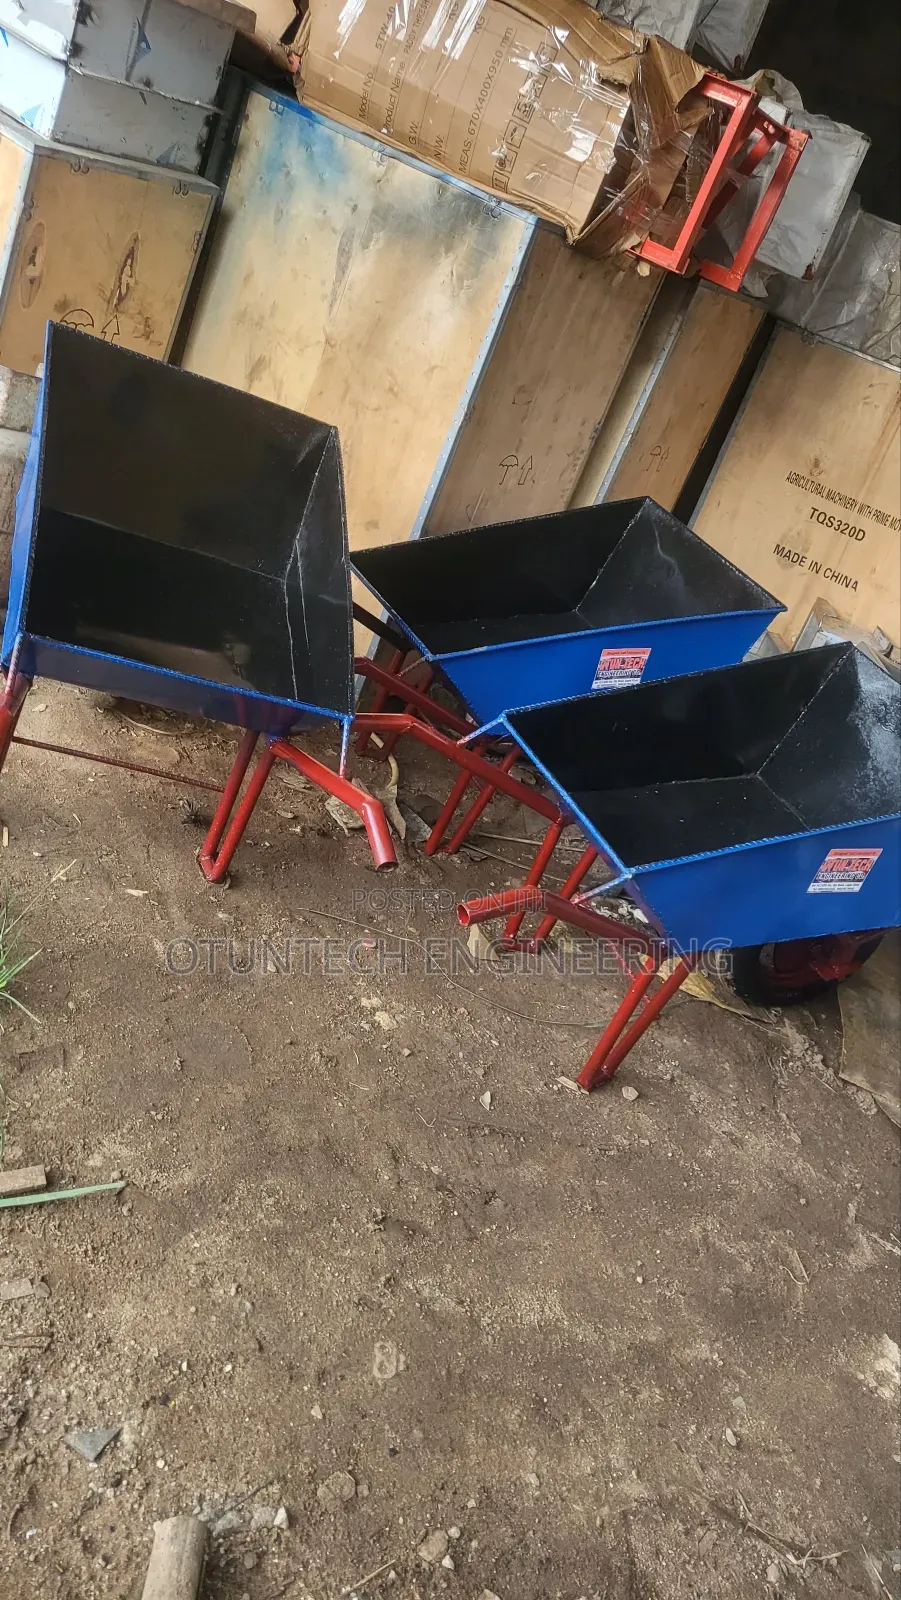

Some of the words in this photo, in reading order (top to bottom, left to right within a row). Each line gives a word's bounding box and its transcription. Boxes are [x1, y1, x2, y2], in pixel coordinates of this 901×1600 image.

[391, 61, 405, 94] Name
[403, 30, 417, 55] PADDY
[467, 50, 503, 137] 670X400X950
[500, 27, 514, 50] mm
[359, 91, 370, 119] Model
[785, 470, 826, 499] AGRICULTURAL
[825, 487, 859, 512] MACHINERY
[857, 501, 873, 519] WITH
[870, 508, 892, 528] PRIME
[808, 506, 866, 542] TQS320D
[773, 543, 807, 568] MADE
[807, 559, 823, 575] IN
[823, 567, 859, 593] CHINA
